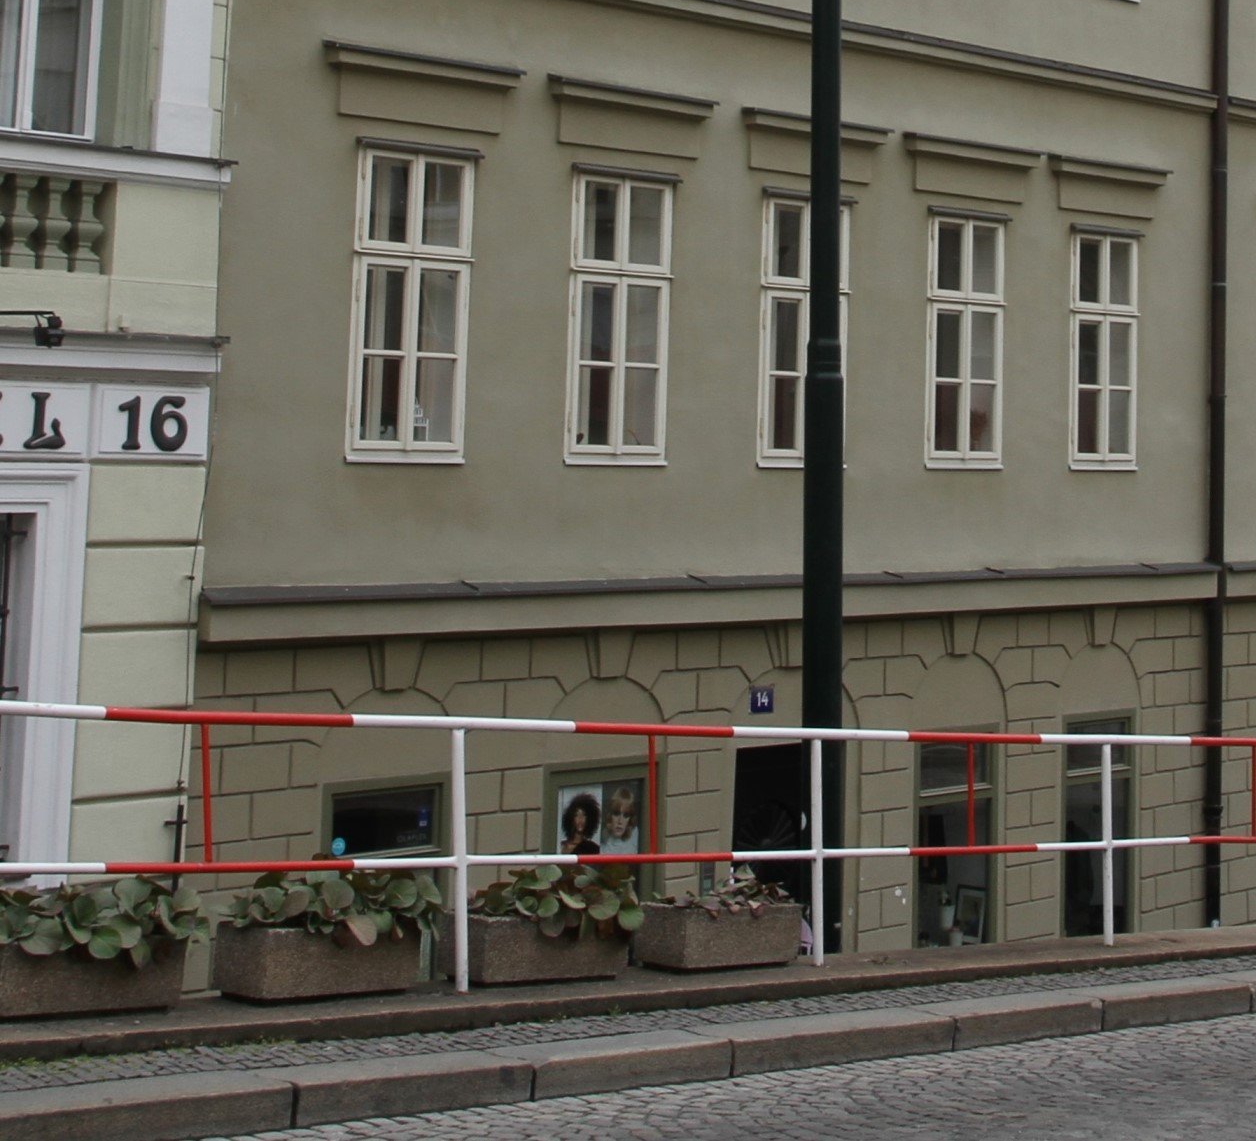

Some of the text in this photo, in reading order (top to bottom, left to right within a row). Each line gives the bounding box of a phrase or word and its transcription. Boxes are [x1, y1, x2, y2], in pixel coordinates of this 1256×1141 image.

[0, 391, 188, 452] L 16
[756, 691, 769, 707] 14
